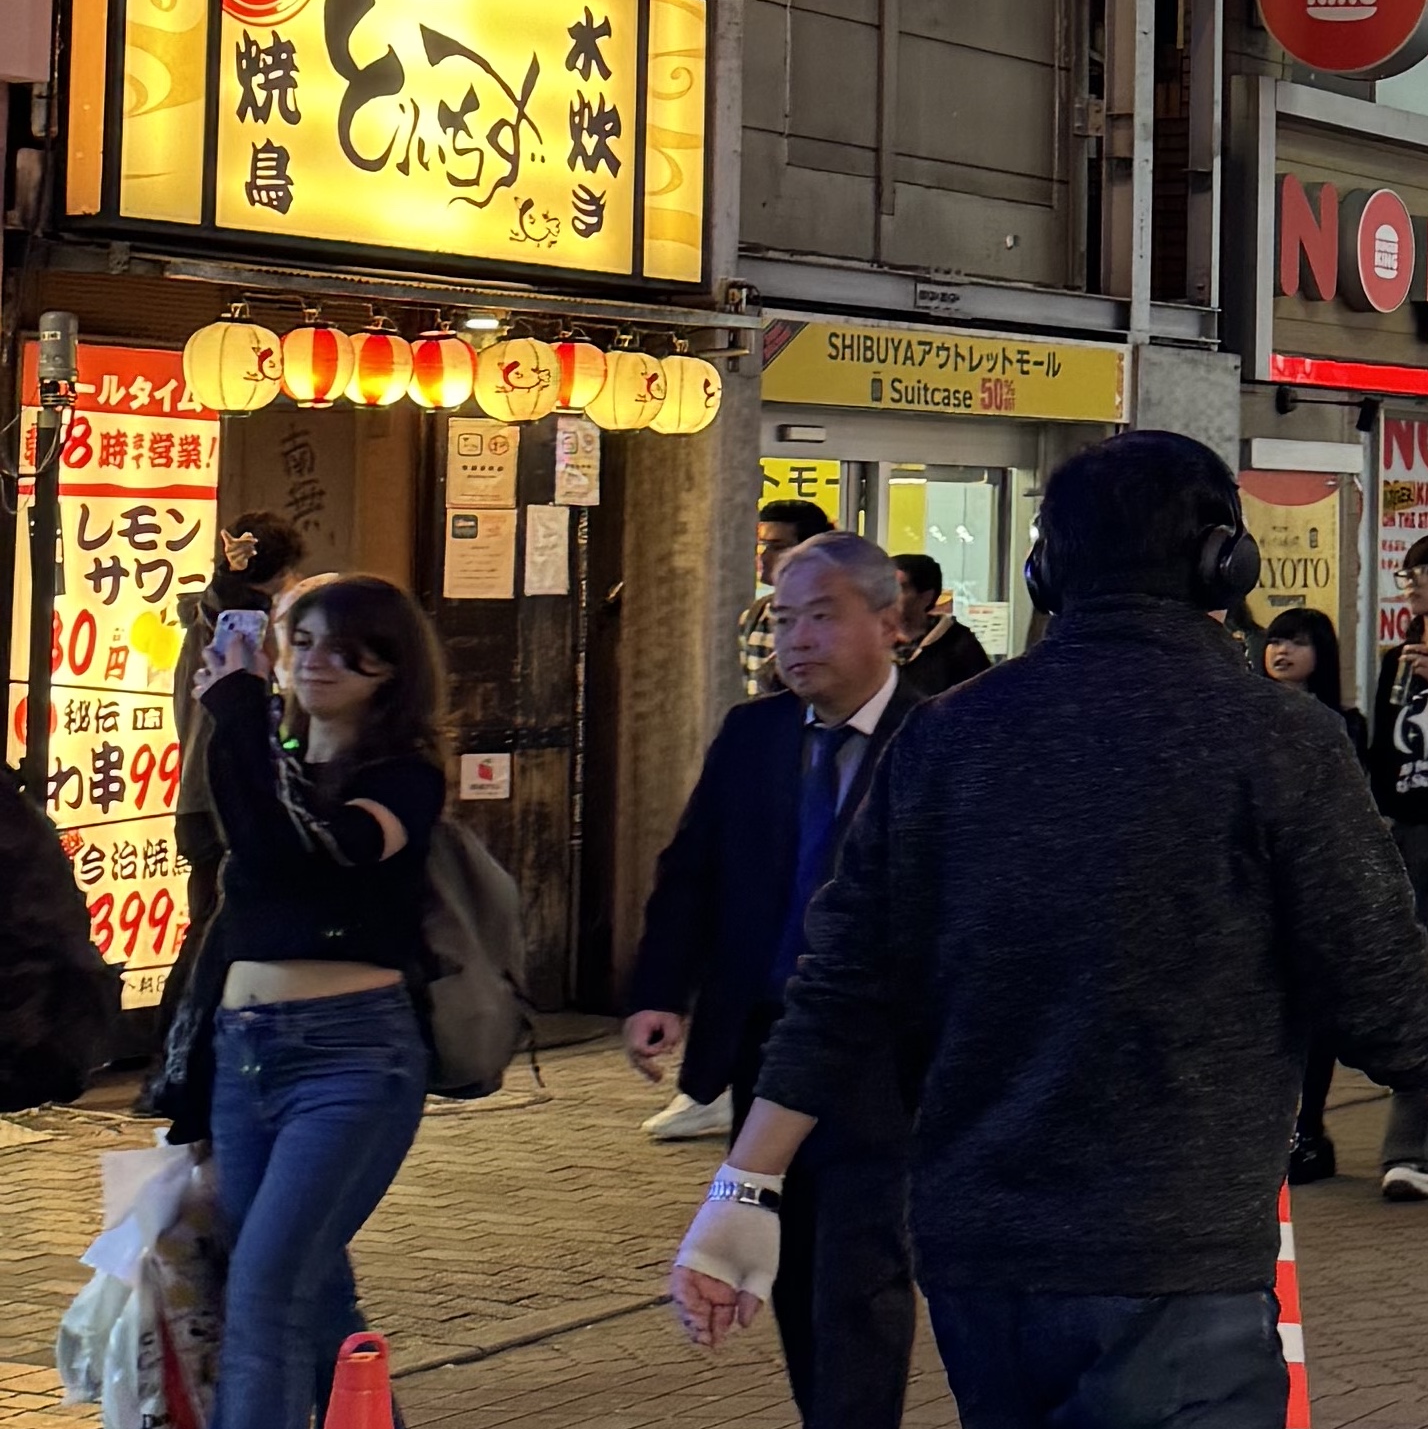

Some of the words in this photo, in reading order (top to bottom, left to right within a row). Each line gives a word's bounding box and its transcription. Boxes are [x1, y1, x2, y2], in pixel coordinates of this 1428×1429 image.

[236, 29, 301, 215] 焼鳥
[566, 5, 622, 239] 水炊き
[828, 331, 1061, 378] SHIBUYAアウトレットモール
[75, 375, 204, 412] ールタイム
[890, 379, 972, 408] Suitcase
[77, 503, 200, 551] レモン
[85, 555, 205, 605] サワー
[65, 698, 120, 735] 秘伝
[47, 742, 124, 814] わ串
[131, 744, 180, 810] 99
